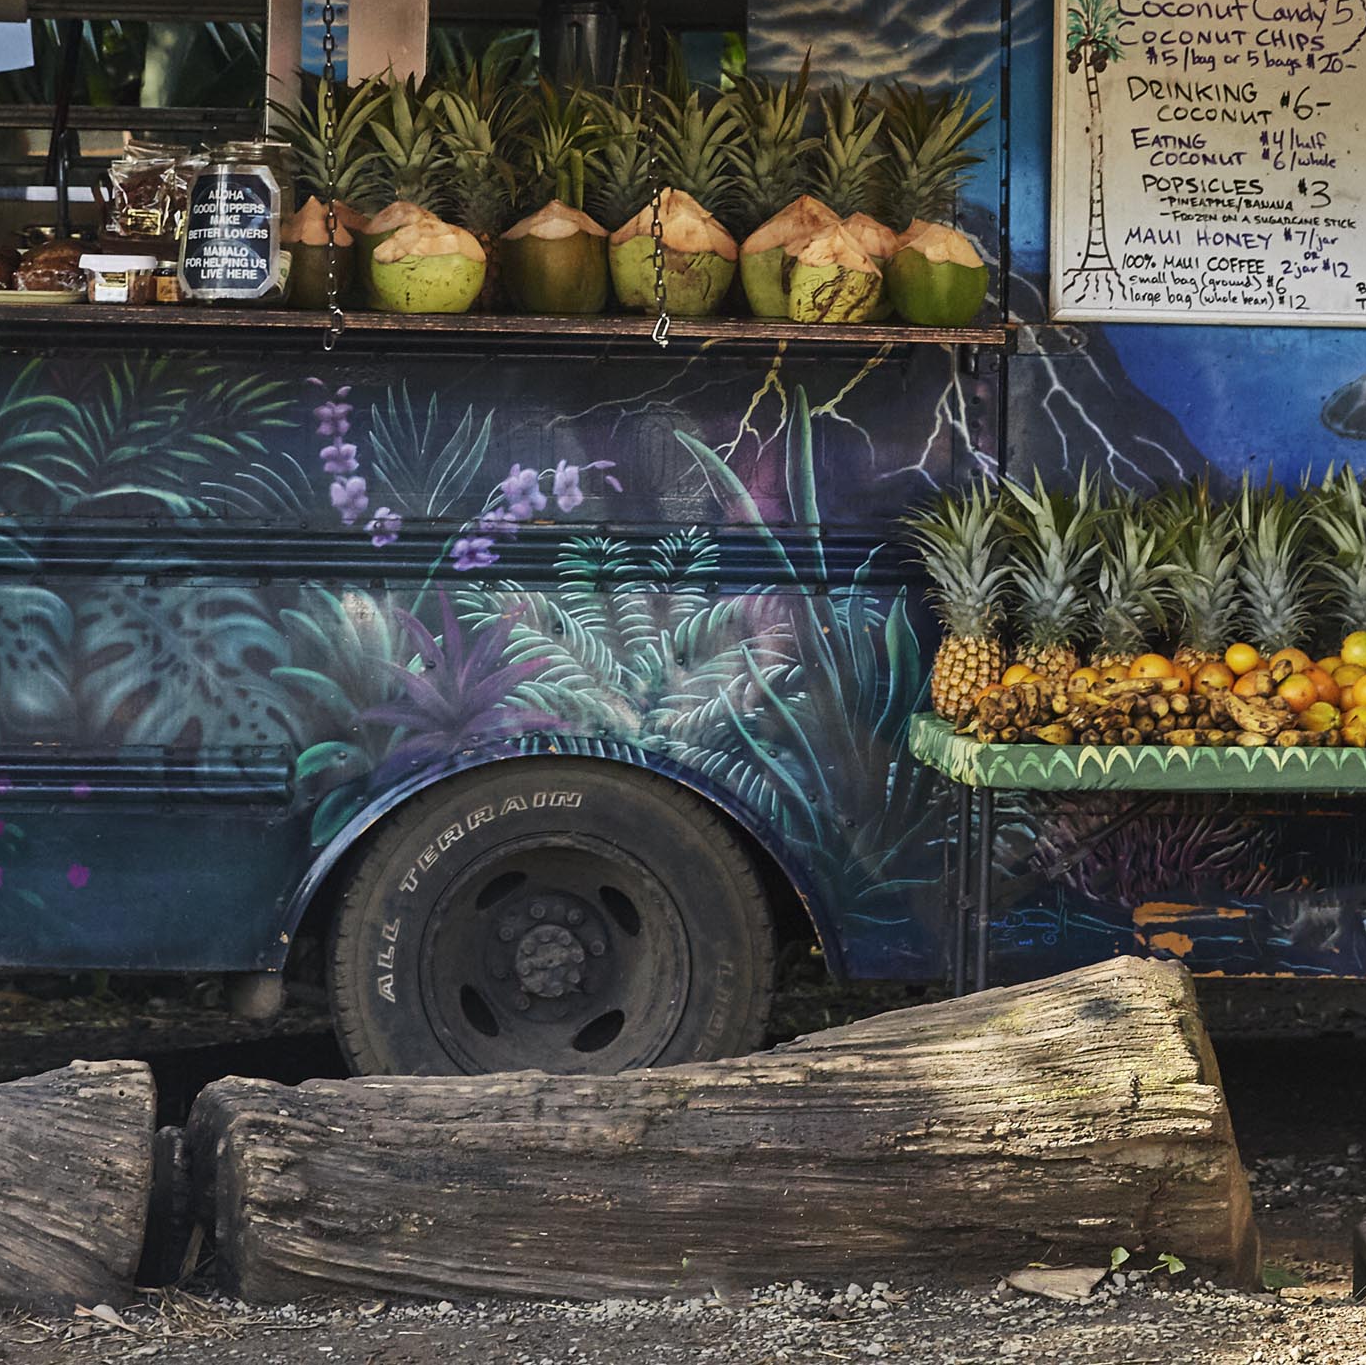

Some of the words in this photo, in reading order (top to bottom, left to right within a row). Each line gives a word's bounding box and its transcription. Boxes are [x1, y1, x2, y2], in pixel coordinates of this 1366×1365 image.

[1116, 21, 1246, 45] COCONUT
[1256, 29, 1325, 51] CHIPS
[1224, 54, 1240, 64] or
[1247, 51, 1259, 65] 5
[1265, 52, 1302, 75] bags
[1127, 76, 1257, 104] DRINKING
[1158, 104, 1272, 125] COCONUT
[1131, 128, 1207, 150] EATING
[1150, 151, 1247, 166] COCONUT
[1142, 175, 1264, 194] POPSICLES
[208, 190, 244, 199] ALOHA
[193, 204, 216, 214] GOOD
[210, 215, 240, 225] MAKE
[1242, 216, 1250, 224] A
[1255, 216, 1320, 225] SUGARCANE
[1324, 218, 1356, 229] STICK
[189, 229, 221, 240] BETTER
[225, 228, 268, 239] LOVERS
[1125, 227, 1181, 245] MAUI
[1197, 230, 1272, 250] HONEY
[204, 247, 248, 257] MAHALO
[1304, 251, 1319, 260] OR
[186, 258, 202, 268] FOR
[203, 258, 248, 268] HELPING
[251, 258, 267, 268] US
[1122, 255, 1156, 269] 100%
[1164, 257, 1199, 269] MAUI
[1207, 257, 1265, 274] COFFEE
[201, 269, 223, 279] LIVE
[227, 269, 258, 279] HERE
[1130, 271, 1166, 285] small
[1174, 274, 1196, 293] bag
[1202, 273, 1262, 290] (ground)
[1130, 288, 1161, 303] large
[1167, 287, 1192, 309] bag
[377, 916, 402, 1003] ALL
[399, 791, 583, 893] TERRAIN
